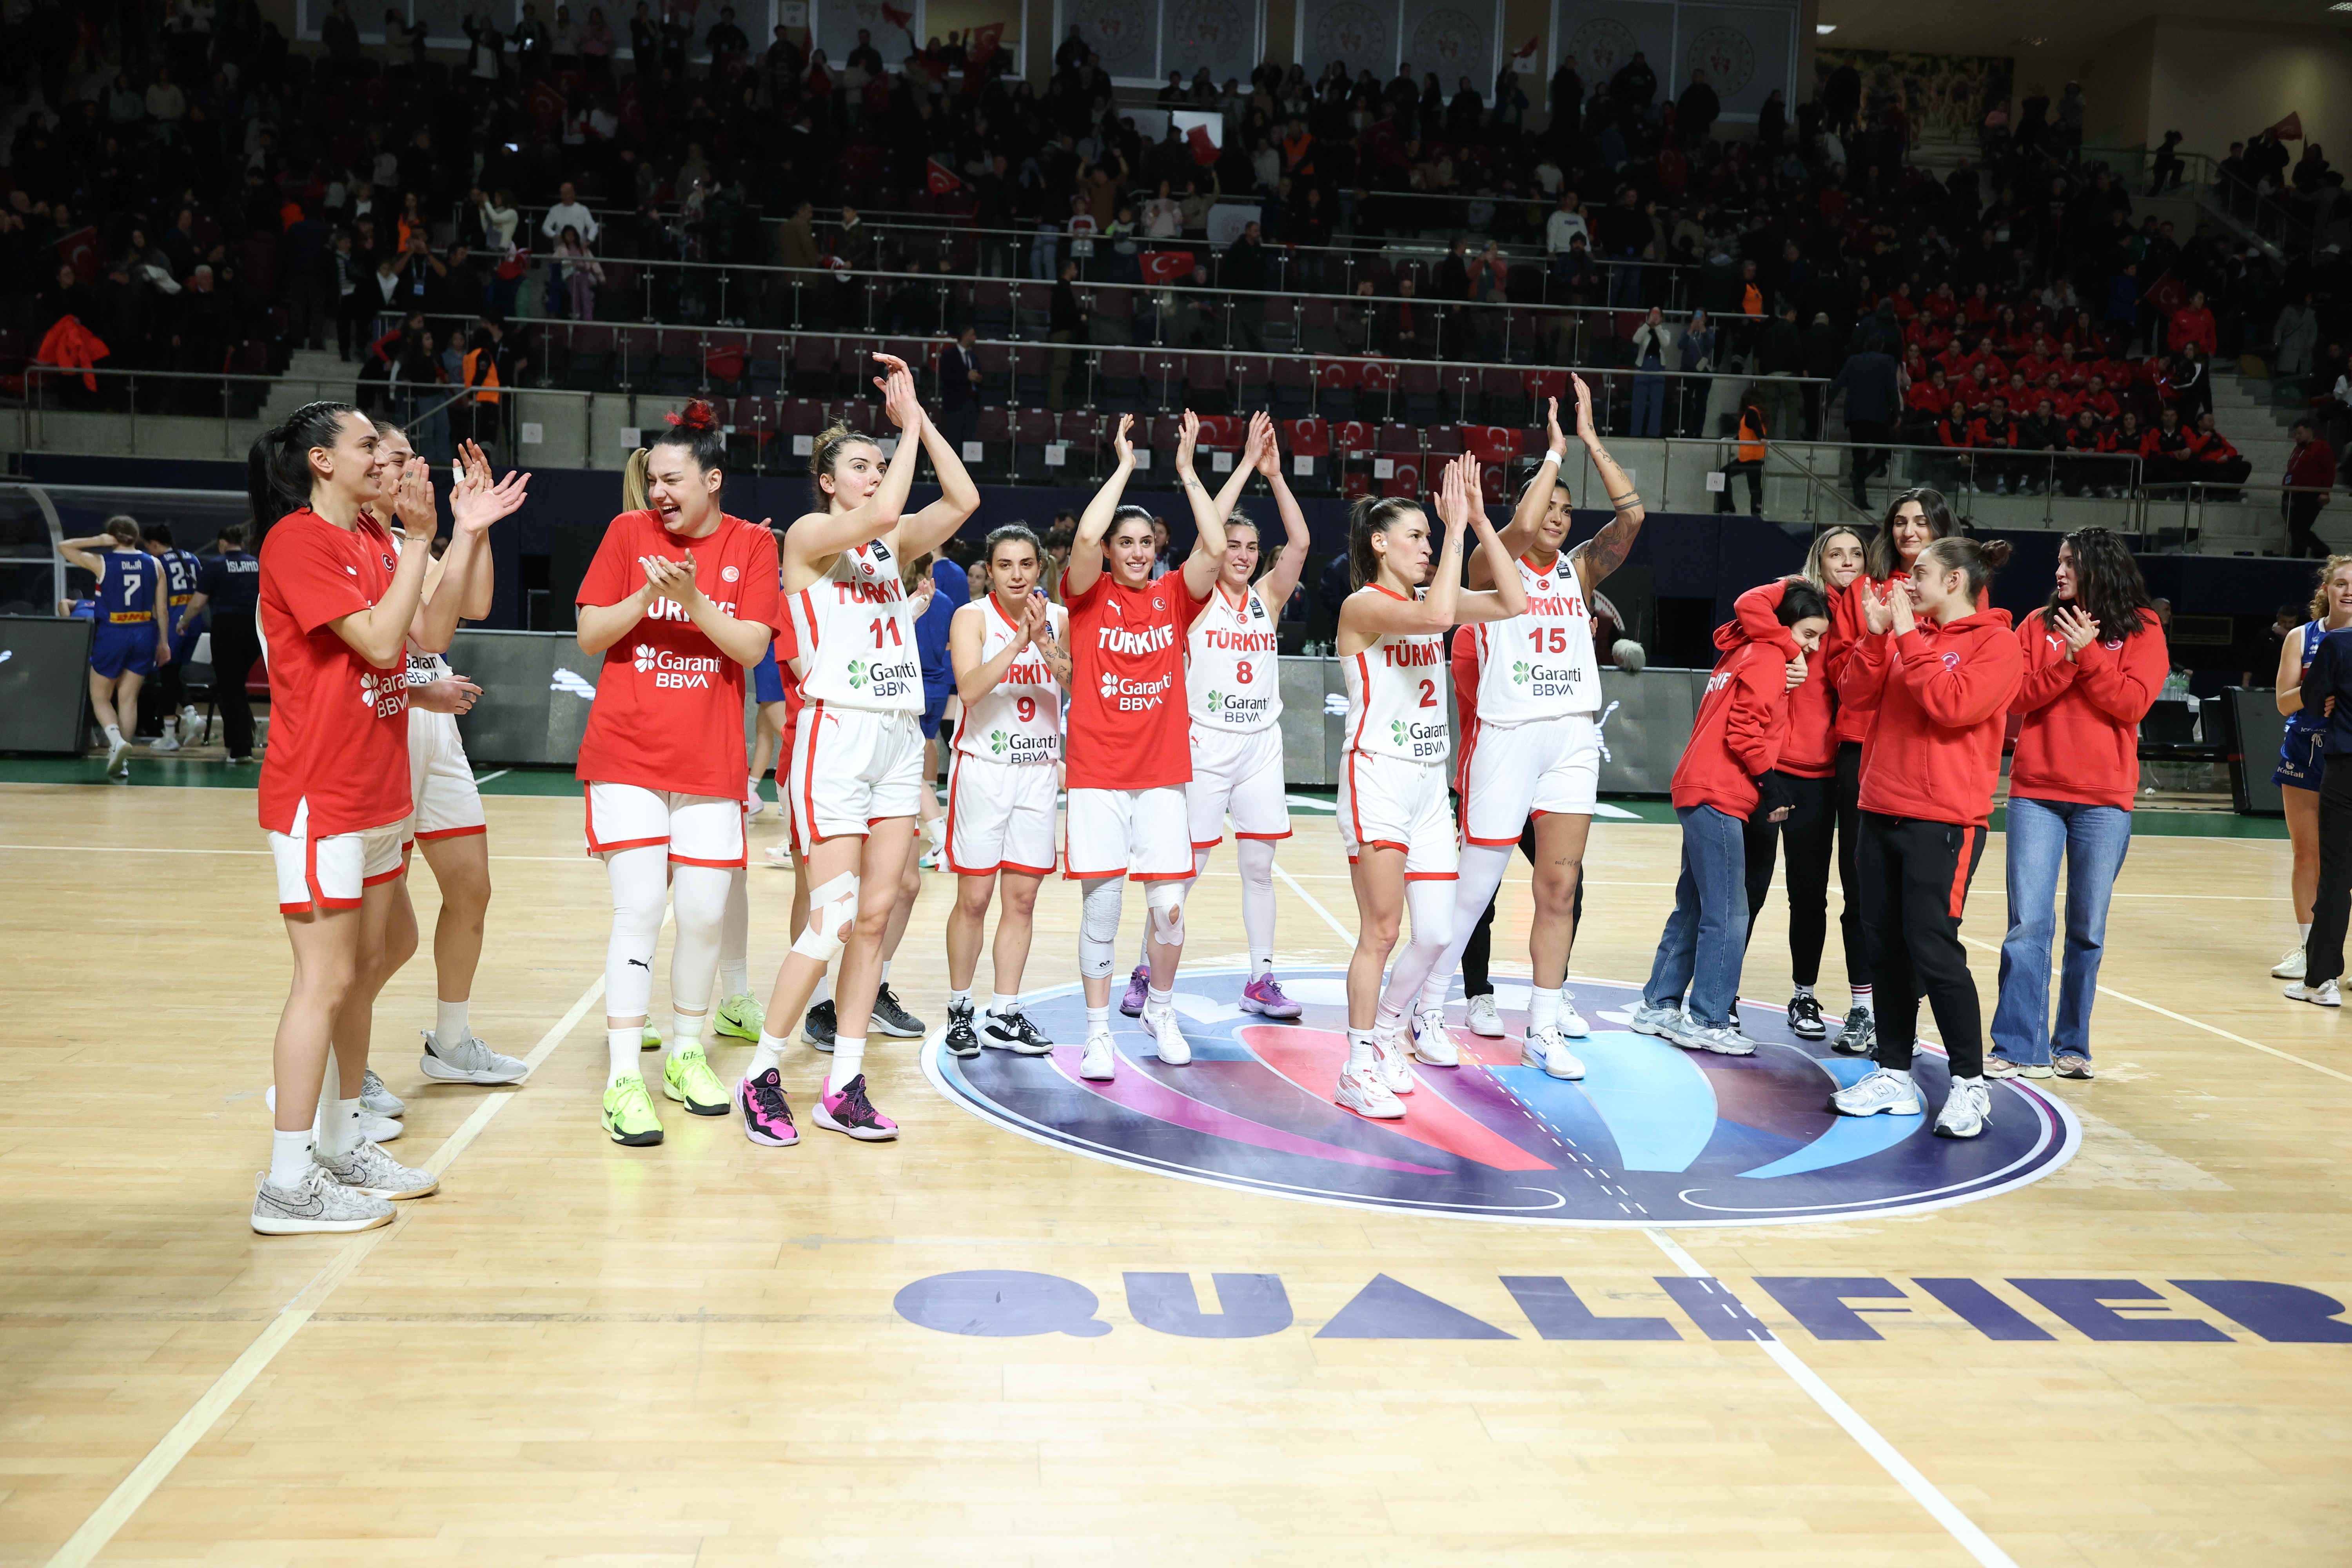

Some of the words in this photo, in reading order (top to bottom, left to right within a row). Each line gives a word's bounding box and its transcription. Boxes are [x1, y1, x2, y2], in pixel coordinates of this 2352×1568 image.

[123, 574, 141, 606] 7
[869, 617, 902, 648] 11
[1098, 623, 1174, 655] TÜRKİYE
[1205, 627, 1276, 652] TÜRKİYE
[1528, 627, 1567, 653] 15
[655, 673, 709, 689] BBVA
[1119, 671, 1172, 695] Garanti
[1236, 661, 1253, 684] 8
[1531, 665, 1581, 682] Garanti
[1419, 679, 1437, 708] 2
[1533, 683, 1573, 696] BBVA
[1017, 696, 1036, 722] 9
[1119, 695, 1163, 711] BBVA
[1224, 695, 1270, 710] Garanti
[1225, 712, 1261, 723] BBVA
[1011, 750, 1049, 764] BBVA
[1413, 740, 1445, 757] BBVA
[2277, 766, 2304, 779] Kristall
[893, 1269, 2352, 1343] QUALIFIER
